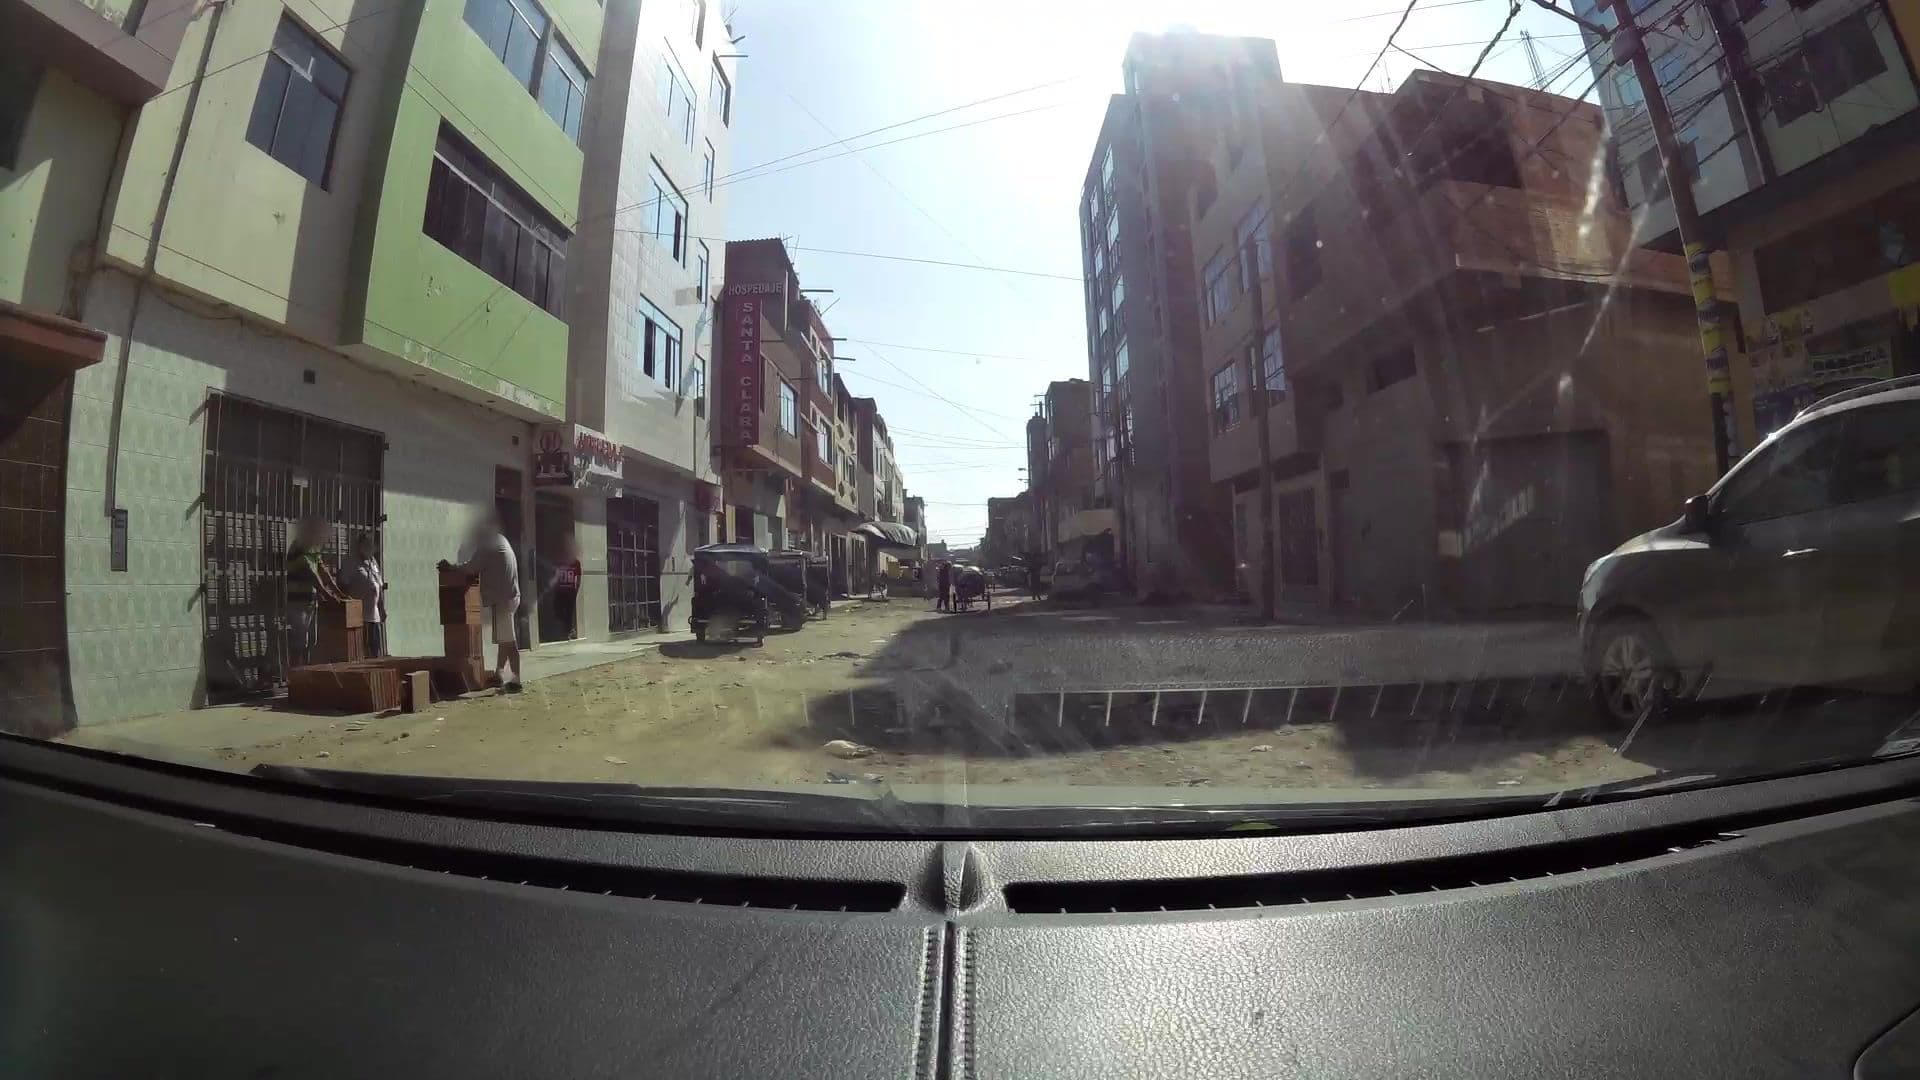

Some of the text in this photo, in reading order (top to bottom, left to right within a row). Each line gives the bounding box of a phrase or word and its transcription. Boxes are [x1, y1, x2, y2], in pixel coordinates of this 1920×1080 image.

[728, 282, 783, 296] HOSPEDAJE
[740, 302, 754, 440] SANTA CLARA
